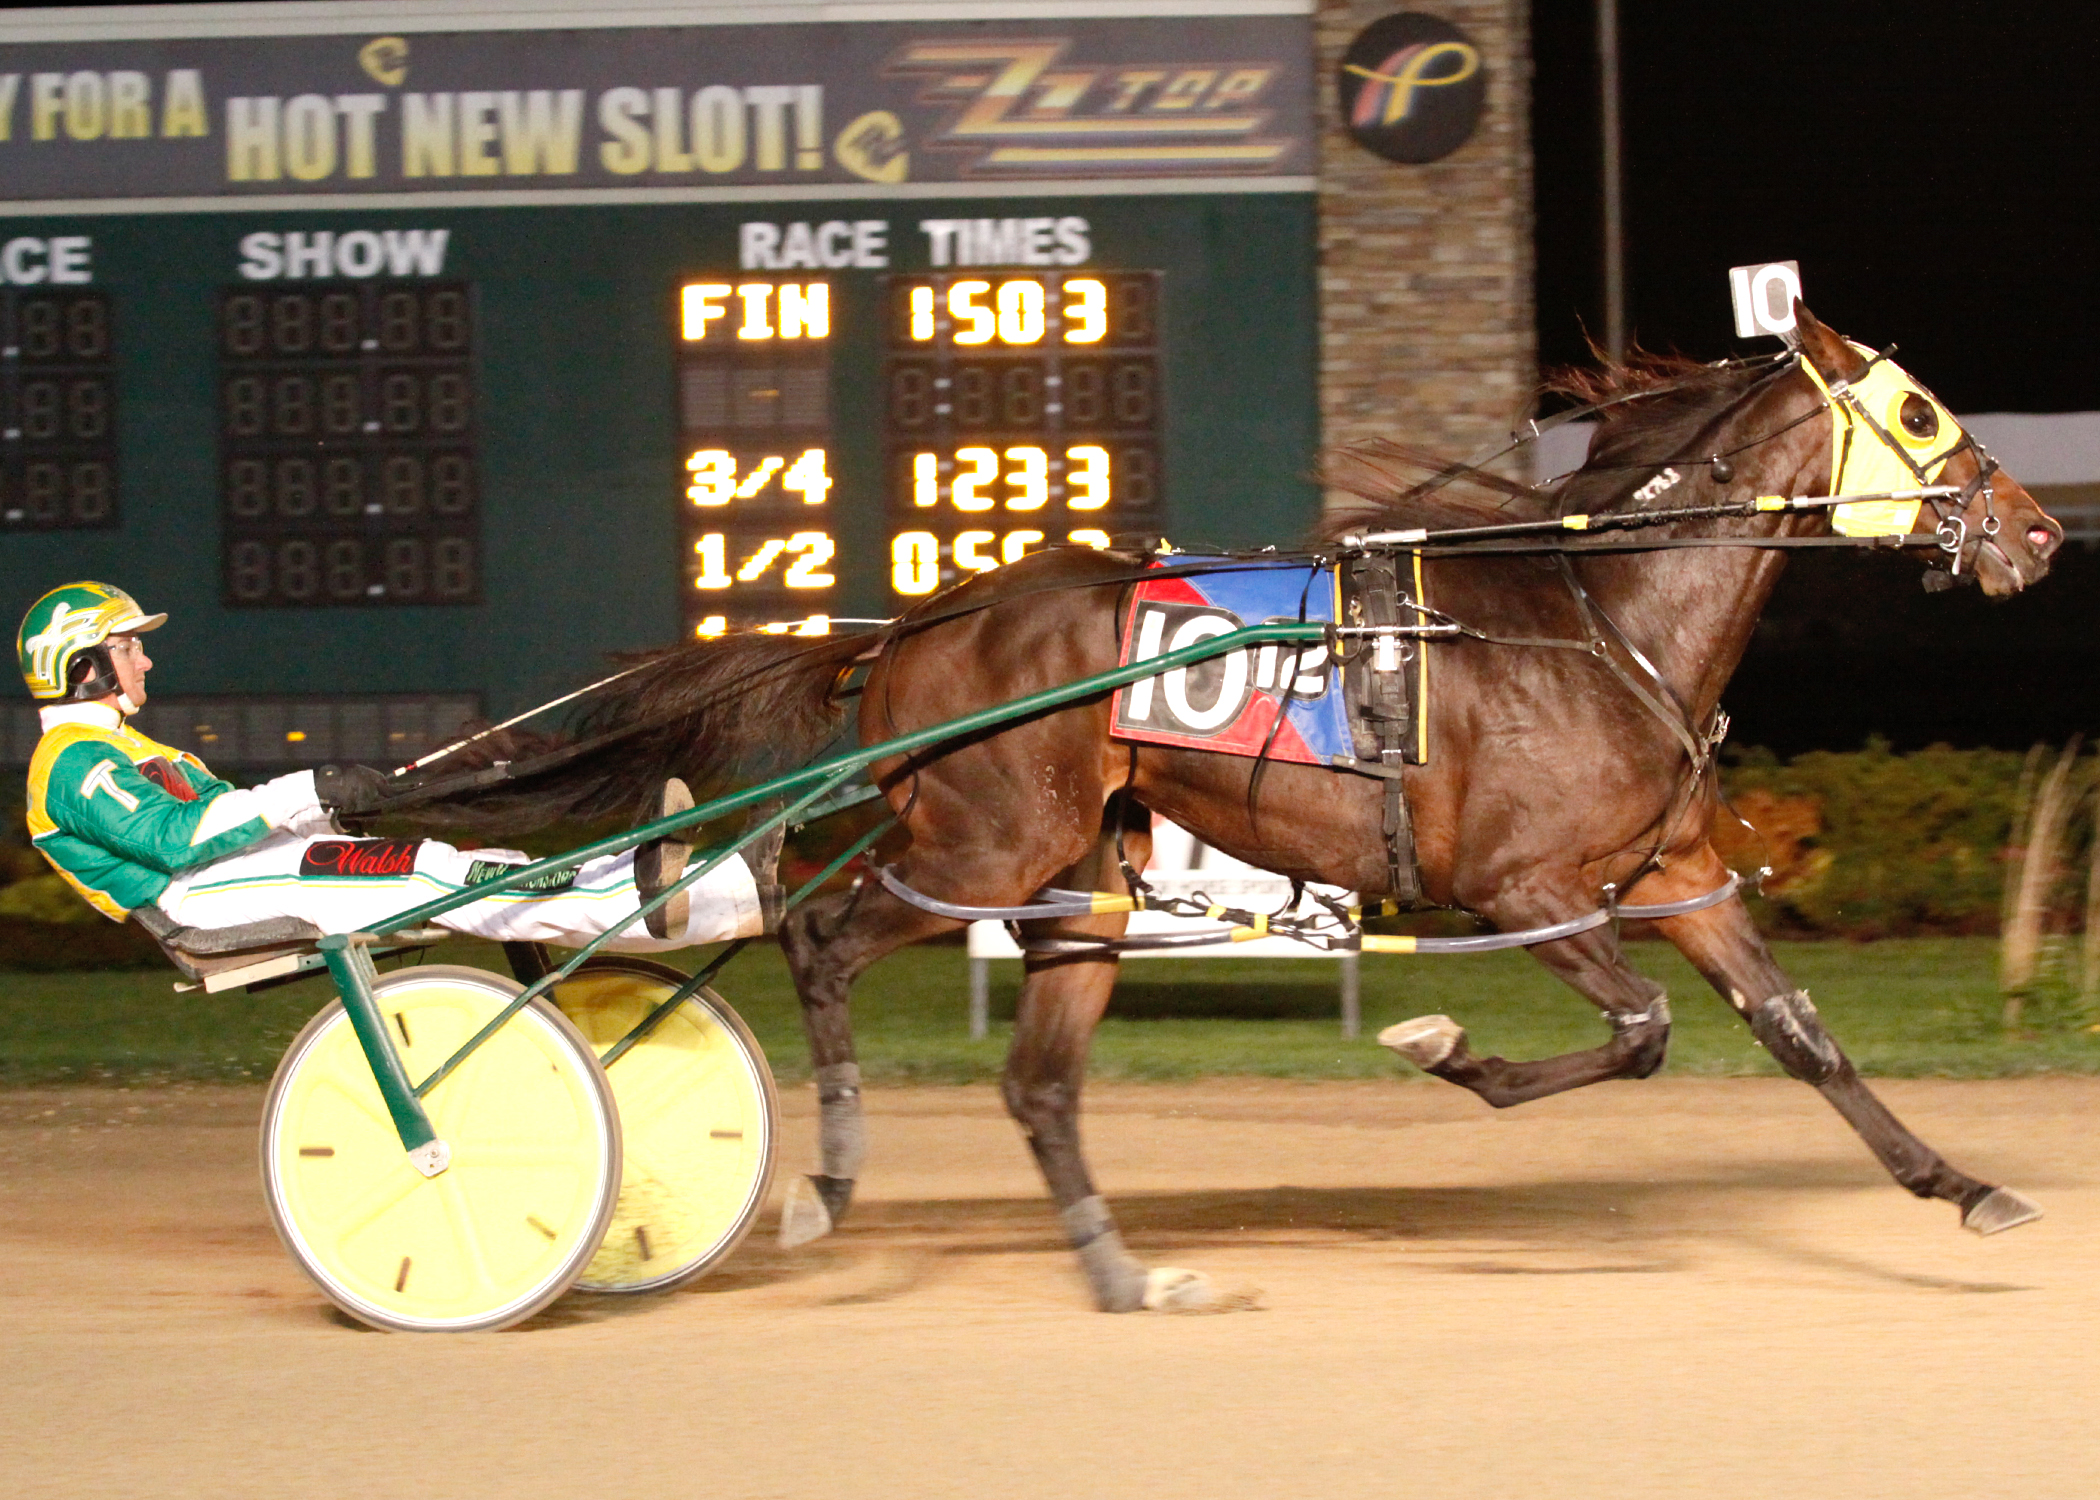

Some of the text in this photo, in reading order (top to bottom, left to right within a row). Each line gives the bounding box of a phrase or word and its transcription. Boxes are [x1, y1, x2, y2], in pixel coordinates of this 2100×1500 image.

[30, 70, 151, 141] FOR
[161, 68, 209, 138] A
[1108, 68, 1277, 112] TOP
[226, 84, 825, 181] HOT NEW SLOT!
[0, 236, 92, 285] CE
[238, 229, 450, 280] SHOW
[739, 216, 1092, 270] RACE TIMES
[681, 282, 830, 341] FIN
[1733, 264, 1803, 338] 10
[686, 448, 833, 507] 3/4
[694, 531, 836, 589] 1/2
[1128, 610, 1249, 730] 10
[81, 759, 140, 812] T
[306, 840, 413, 875] Walsh
